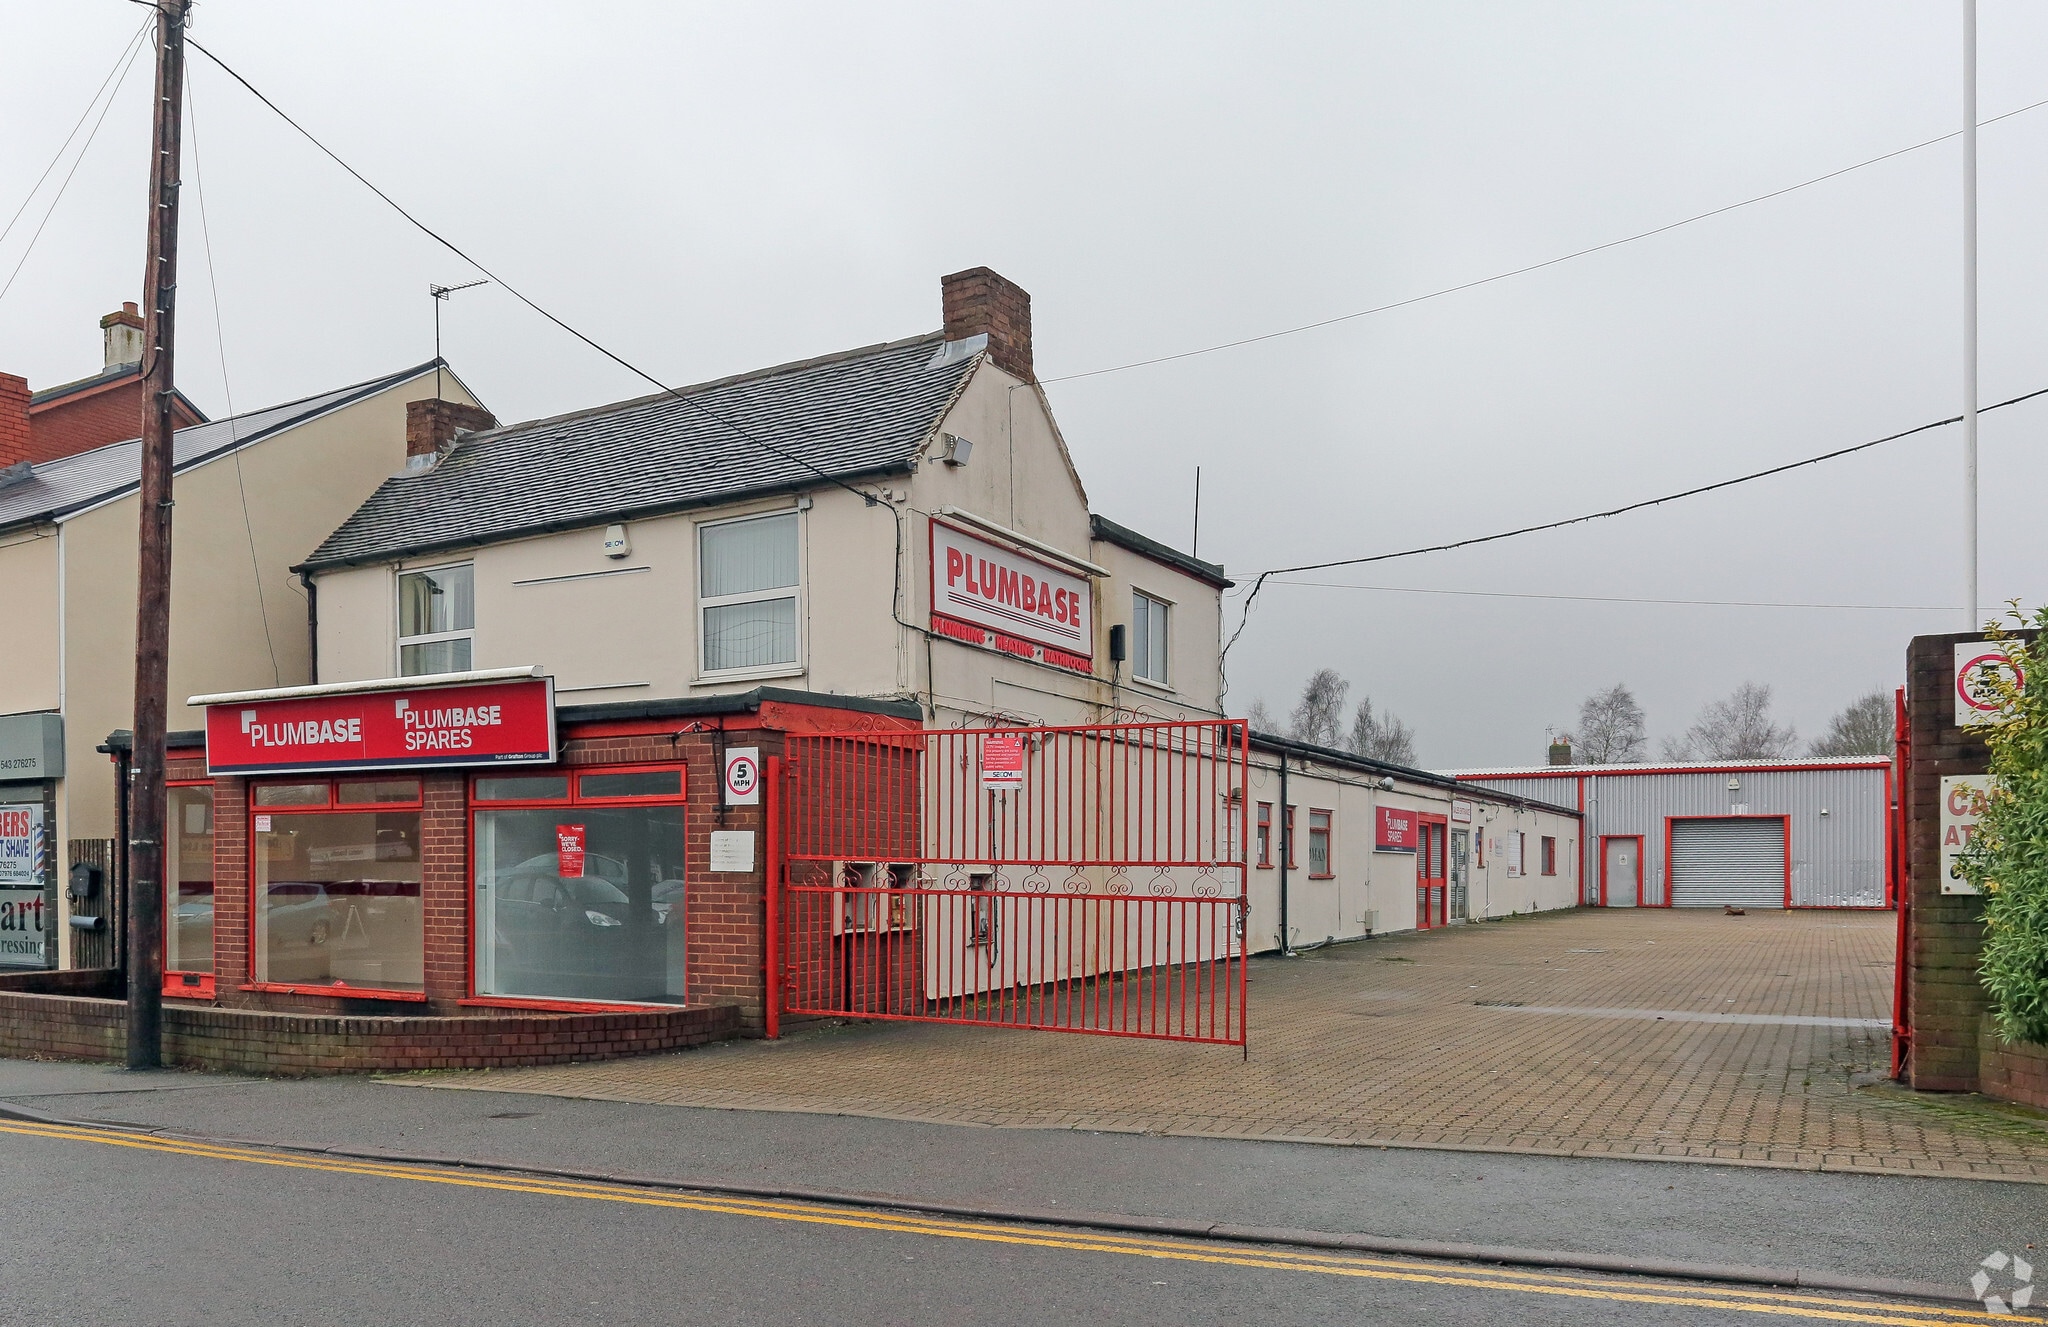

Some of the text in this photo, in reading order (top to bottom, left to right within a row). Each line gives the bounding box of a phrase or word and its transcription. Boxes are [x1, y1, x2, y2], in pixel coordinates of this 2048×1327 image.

[946, 545, 1081, 628] PLUMBASE
[930, 616, 1094, 675] PLUMBING HEATING BATHROOMS
[404, 705, 502, 730] PLUMBASE
[250, 718, 362, 747] PLUMBASE
[405, 728, 473, 751] SPARES
[13, 758, 37, 769] 276275
[736, 764, 748, 779] 5
[0, 811, 29, 838] ERS
[1387, 818, 1408, 832] PLUMBASE
[1387, 830, 1403, 843] SPARES
[5, 839, 29, 858] SHAVE
[1, 892, 44, 932] art
